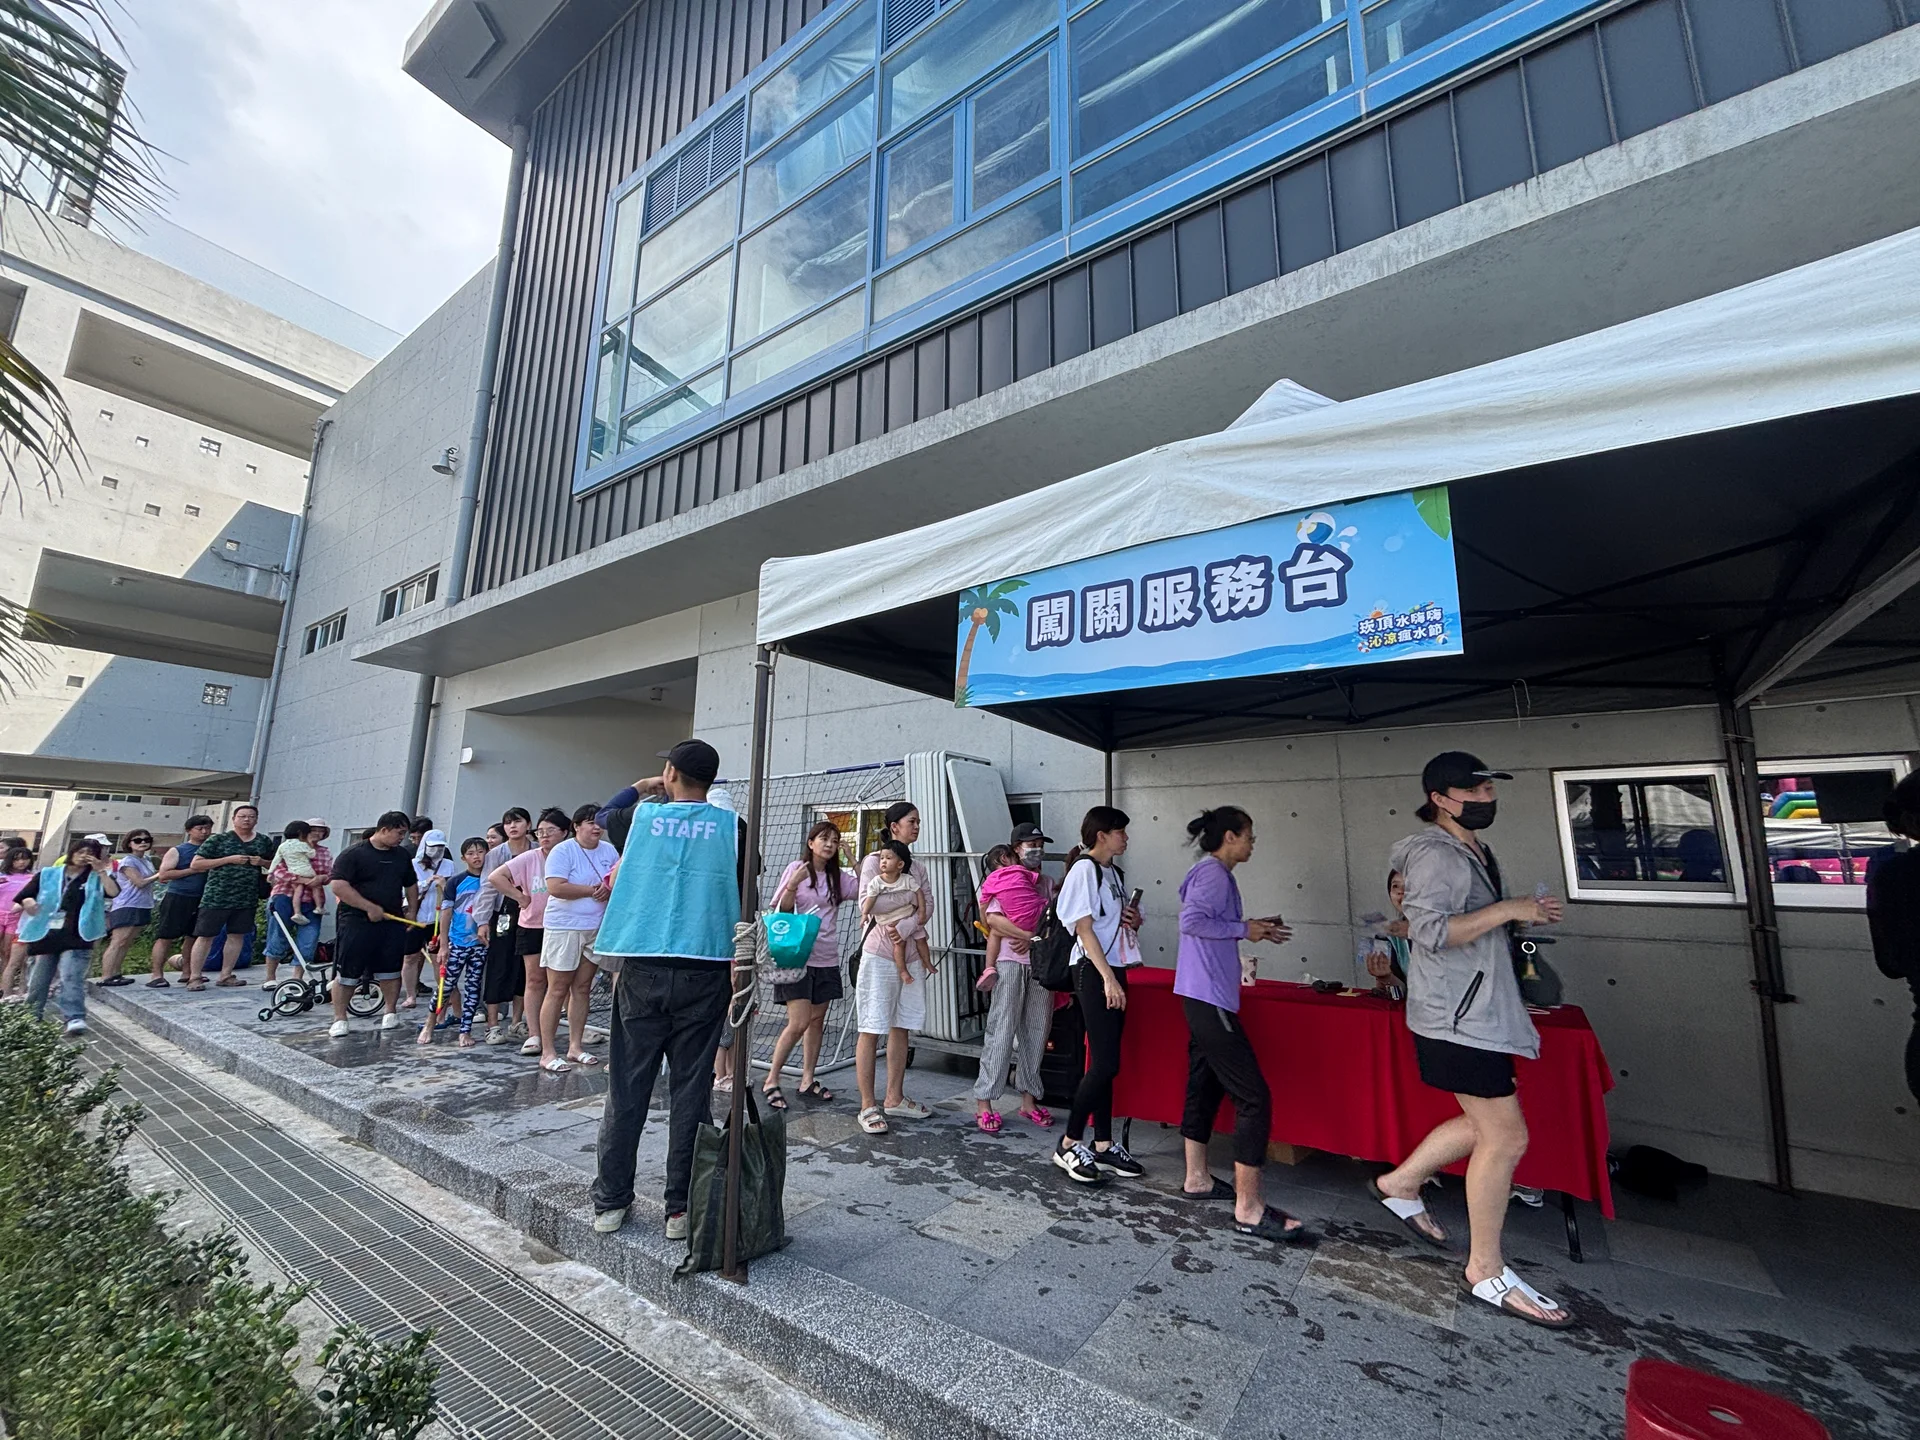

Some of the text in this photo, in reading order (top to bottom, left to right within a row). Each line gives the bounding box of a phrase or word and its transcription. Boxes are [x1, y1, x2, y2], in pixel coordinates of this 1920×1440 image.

[1030, 550, 1347, 646] 闖關服務台
[1359, 608, 1442, 635] 崁頂水嗨嗨
[1368, 623, 1443, 648] 沁涼瘋水節
[650, 816, 717, 840] STAFF
